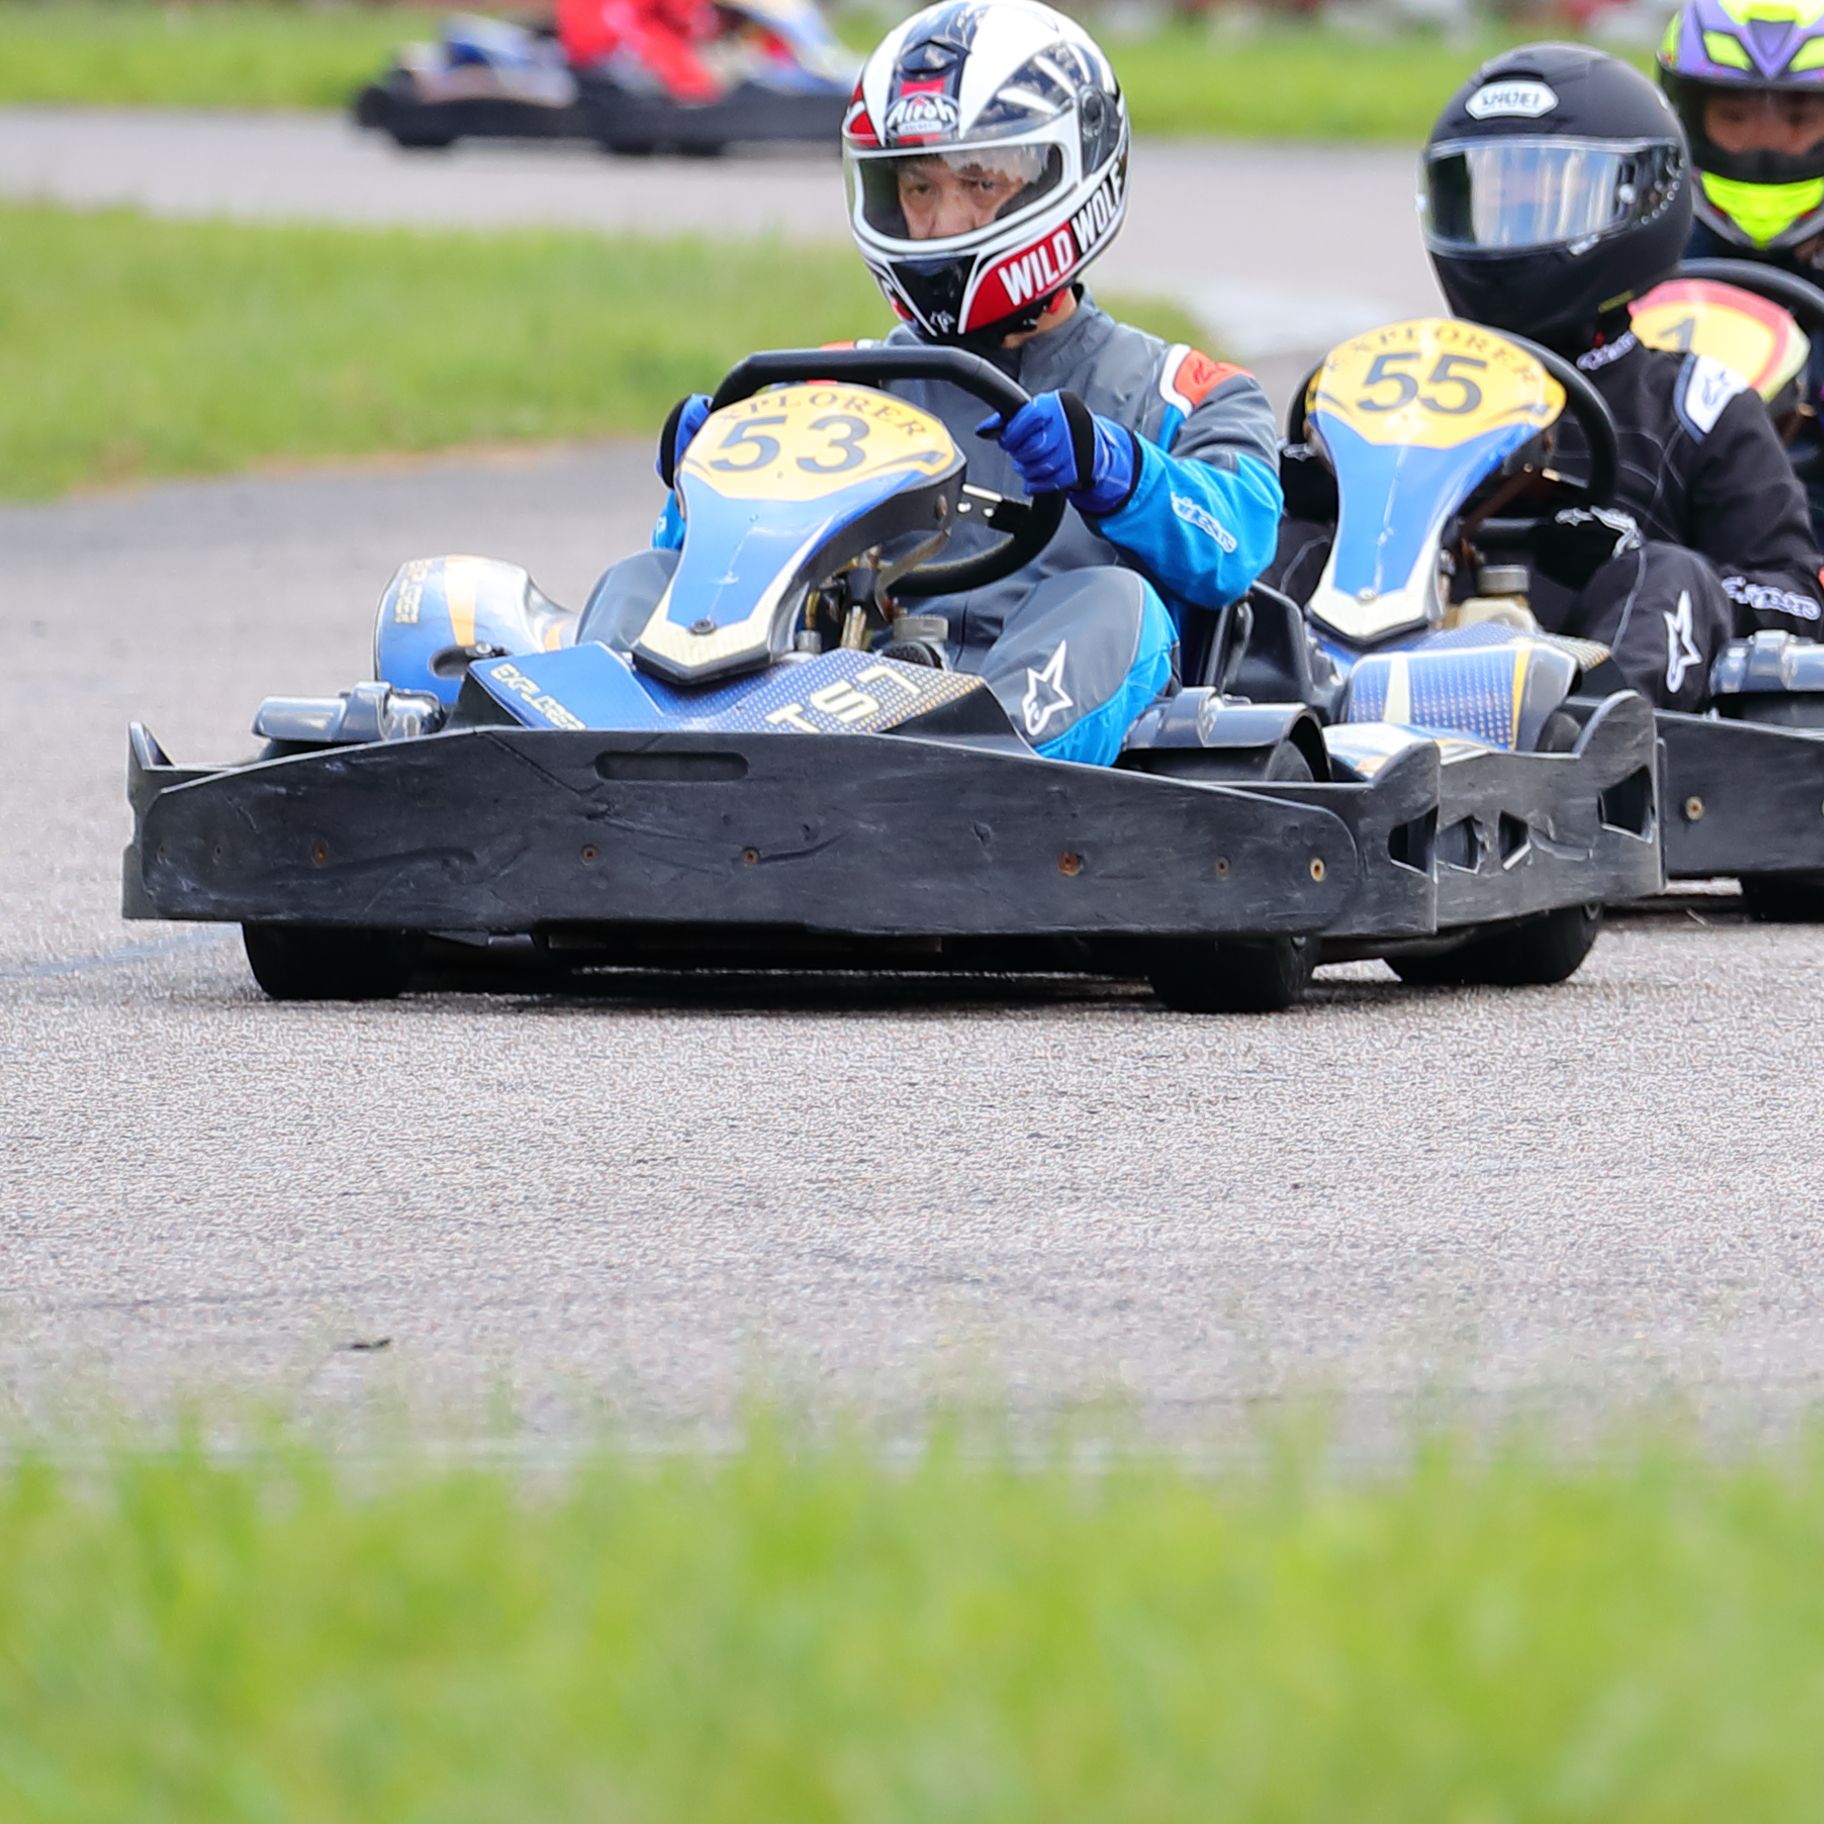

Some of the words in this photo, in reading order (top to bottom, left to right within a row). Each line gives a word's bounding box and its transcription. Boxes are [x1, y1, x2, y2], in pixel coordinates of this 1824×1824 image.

[998, 229, 1075, 306] WILD
[1071, 159, 1123, 254] WOLF
[706, 391, 926, 437] XPLORER
[1356, 352, 1488, 415] 55
[708, 414, 870, 474] 53
[763, 664, 922, 734] TS7
